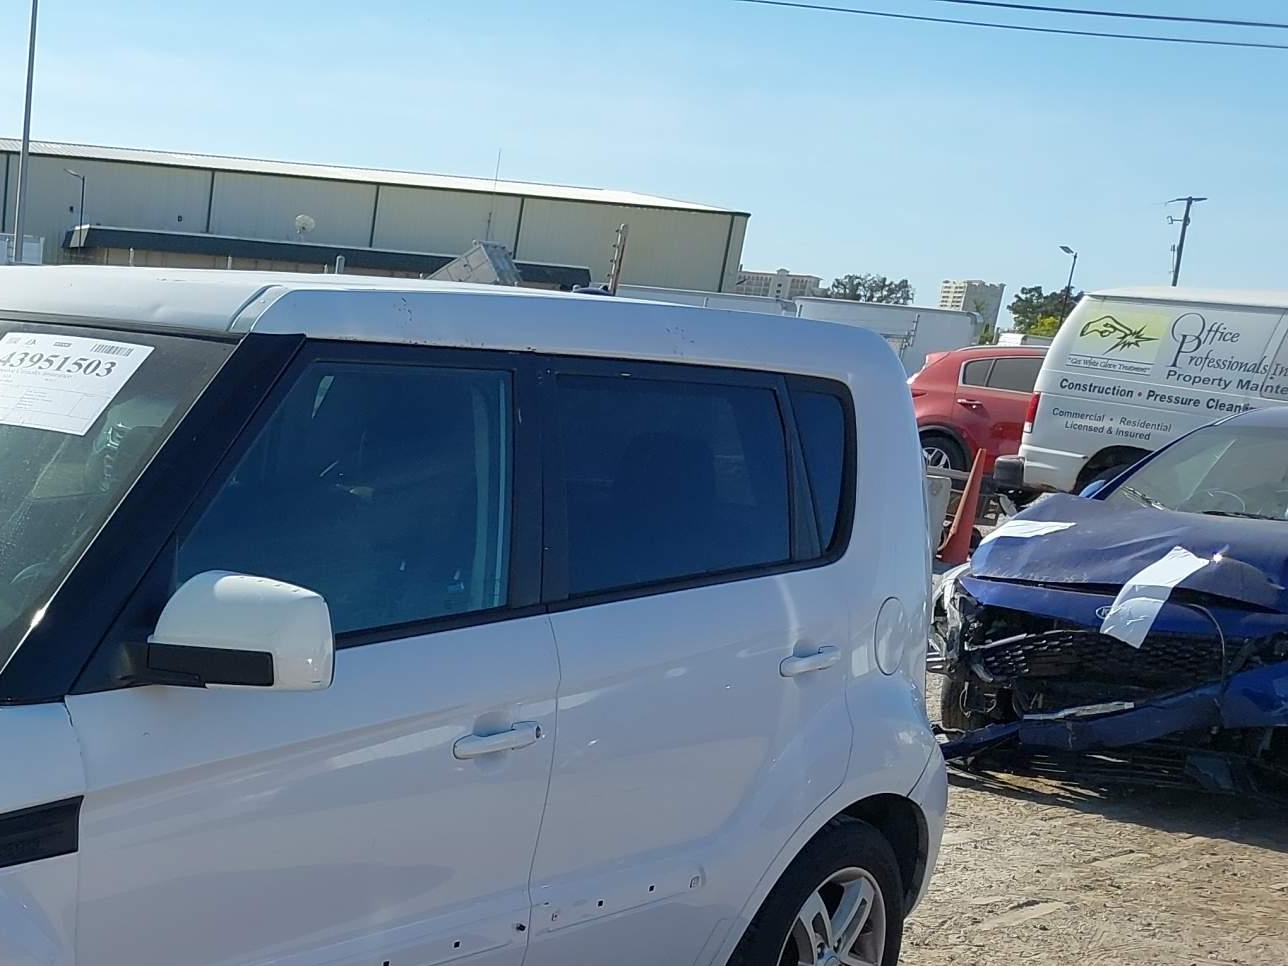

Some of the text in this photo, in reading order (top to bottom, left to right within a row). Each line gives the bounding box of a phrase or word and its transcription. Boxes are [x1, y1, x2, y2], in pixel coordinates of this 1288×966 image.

[1171, 312, 1240, 345] Office
[1165, 334, 1269, 375] Professionals
[1059, 378, 1134, 399] Construction
[1146, 389, 1201, 408] Pressure
[1166, 369, 1232, 390] Property
[1052, 407, 1172, 433] Commercial Residential
[1064, 420, 1104, 434] Licensed
[1106, 426, 1113, 435] &
